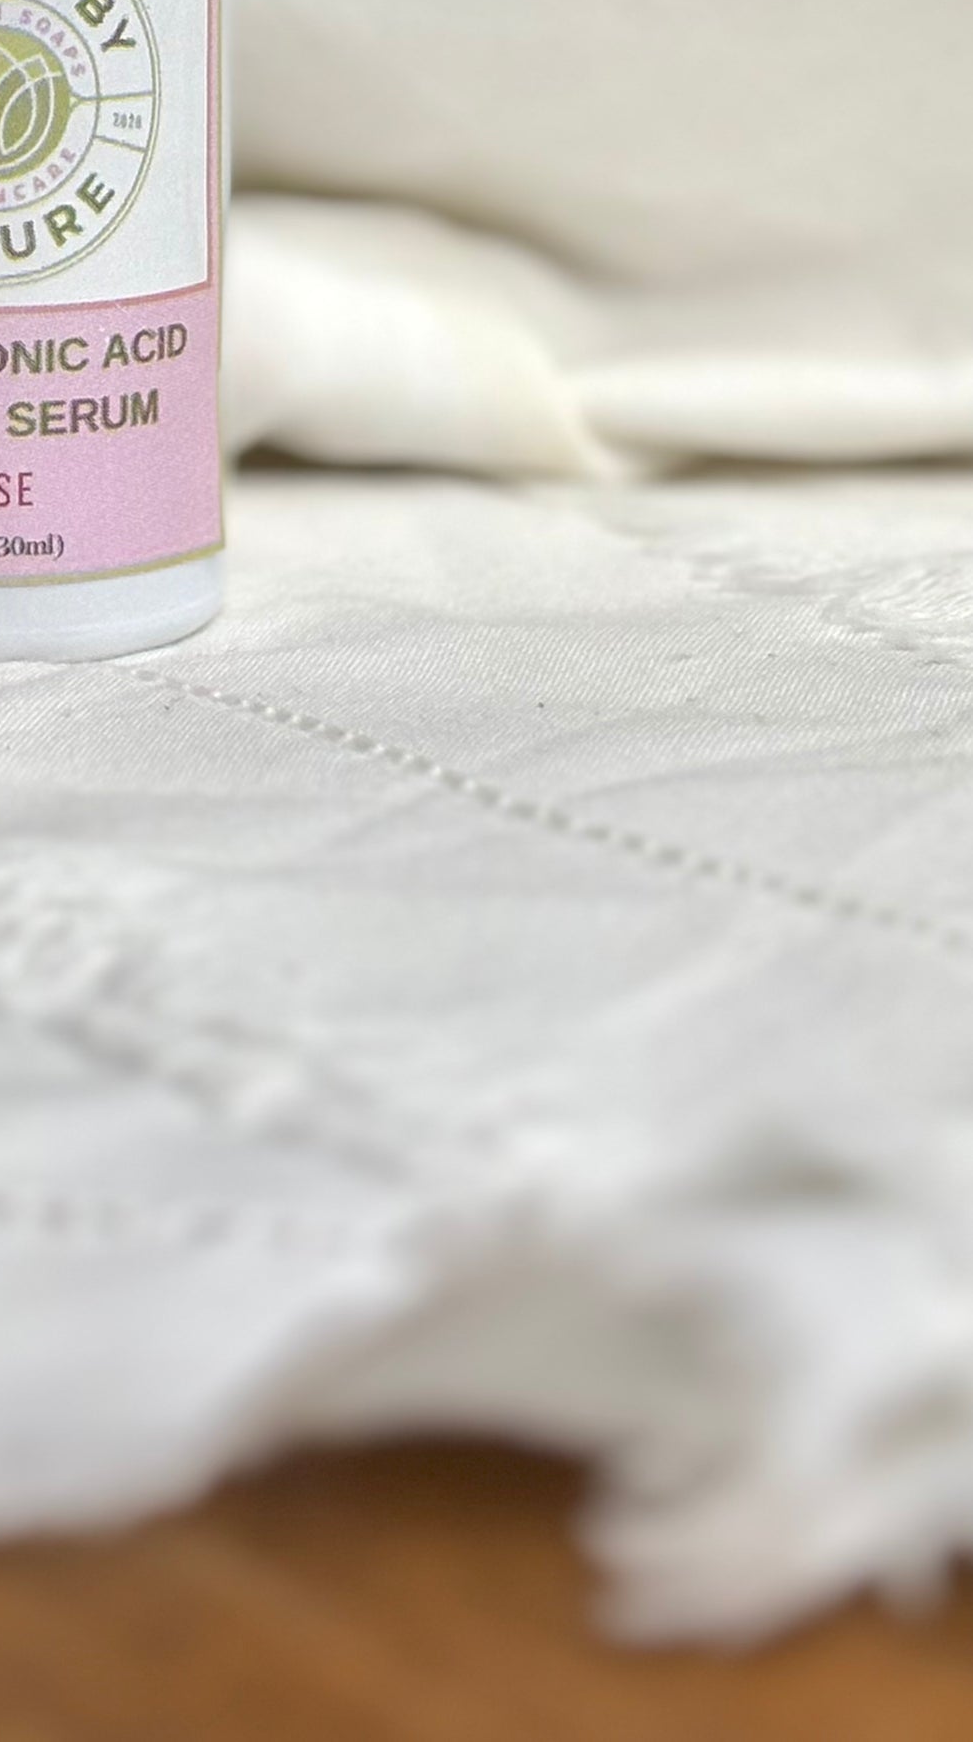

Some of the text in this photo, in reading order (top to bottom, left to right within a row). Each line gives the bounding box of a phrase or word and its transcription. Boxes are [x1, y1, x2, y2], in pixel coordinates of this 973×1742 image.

[19, 8, 86, 77] SOAPS
[102, 323, 188, 369] ACID
[6, 389, 160, 437] SERUM
